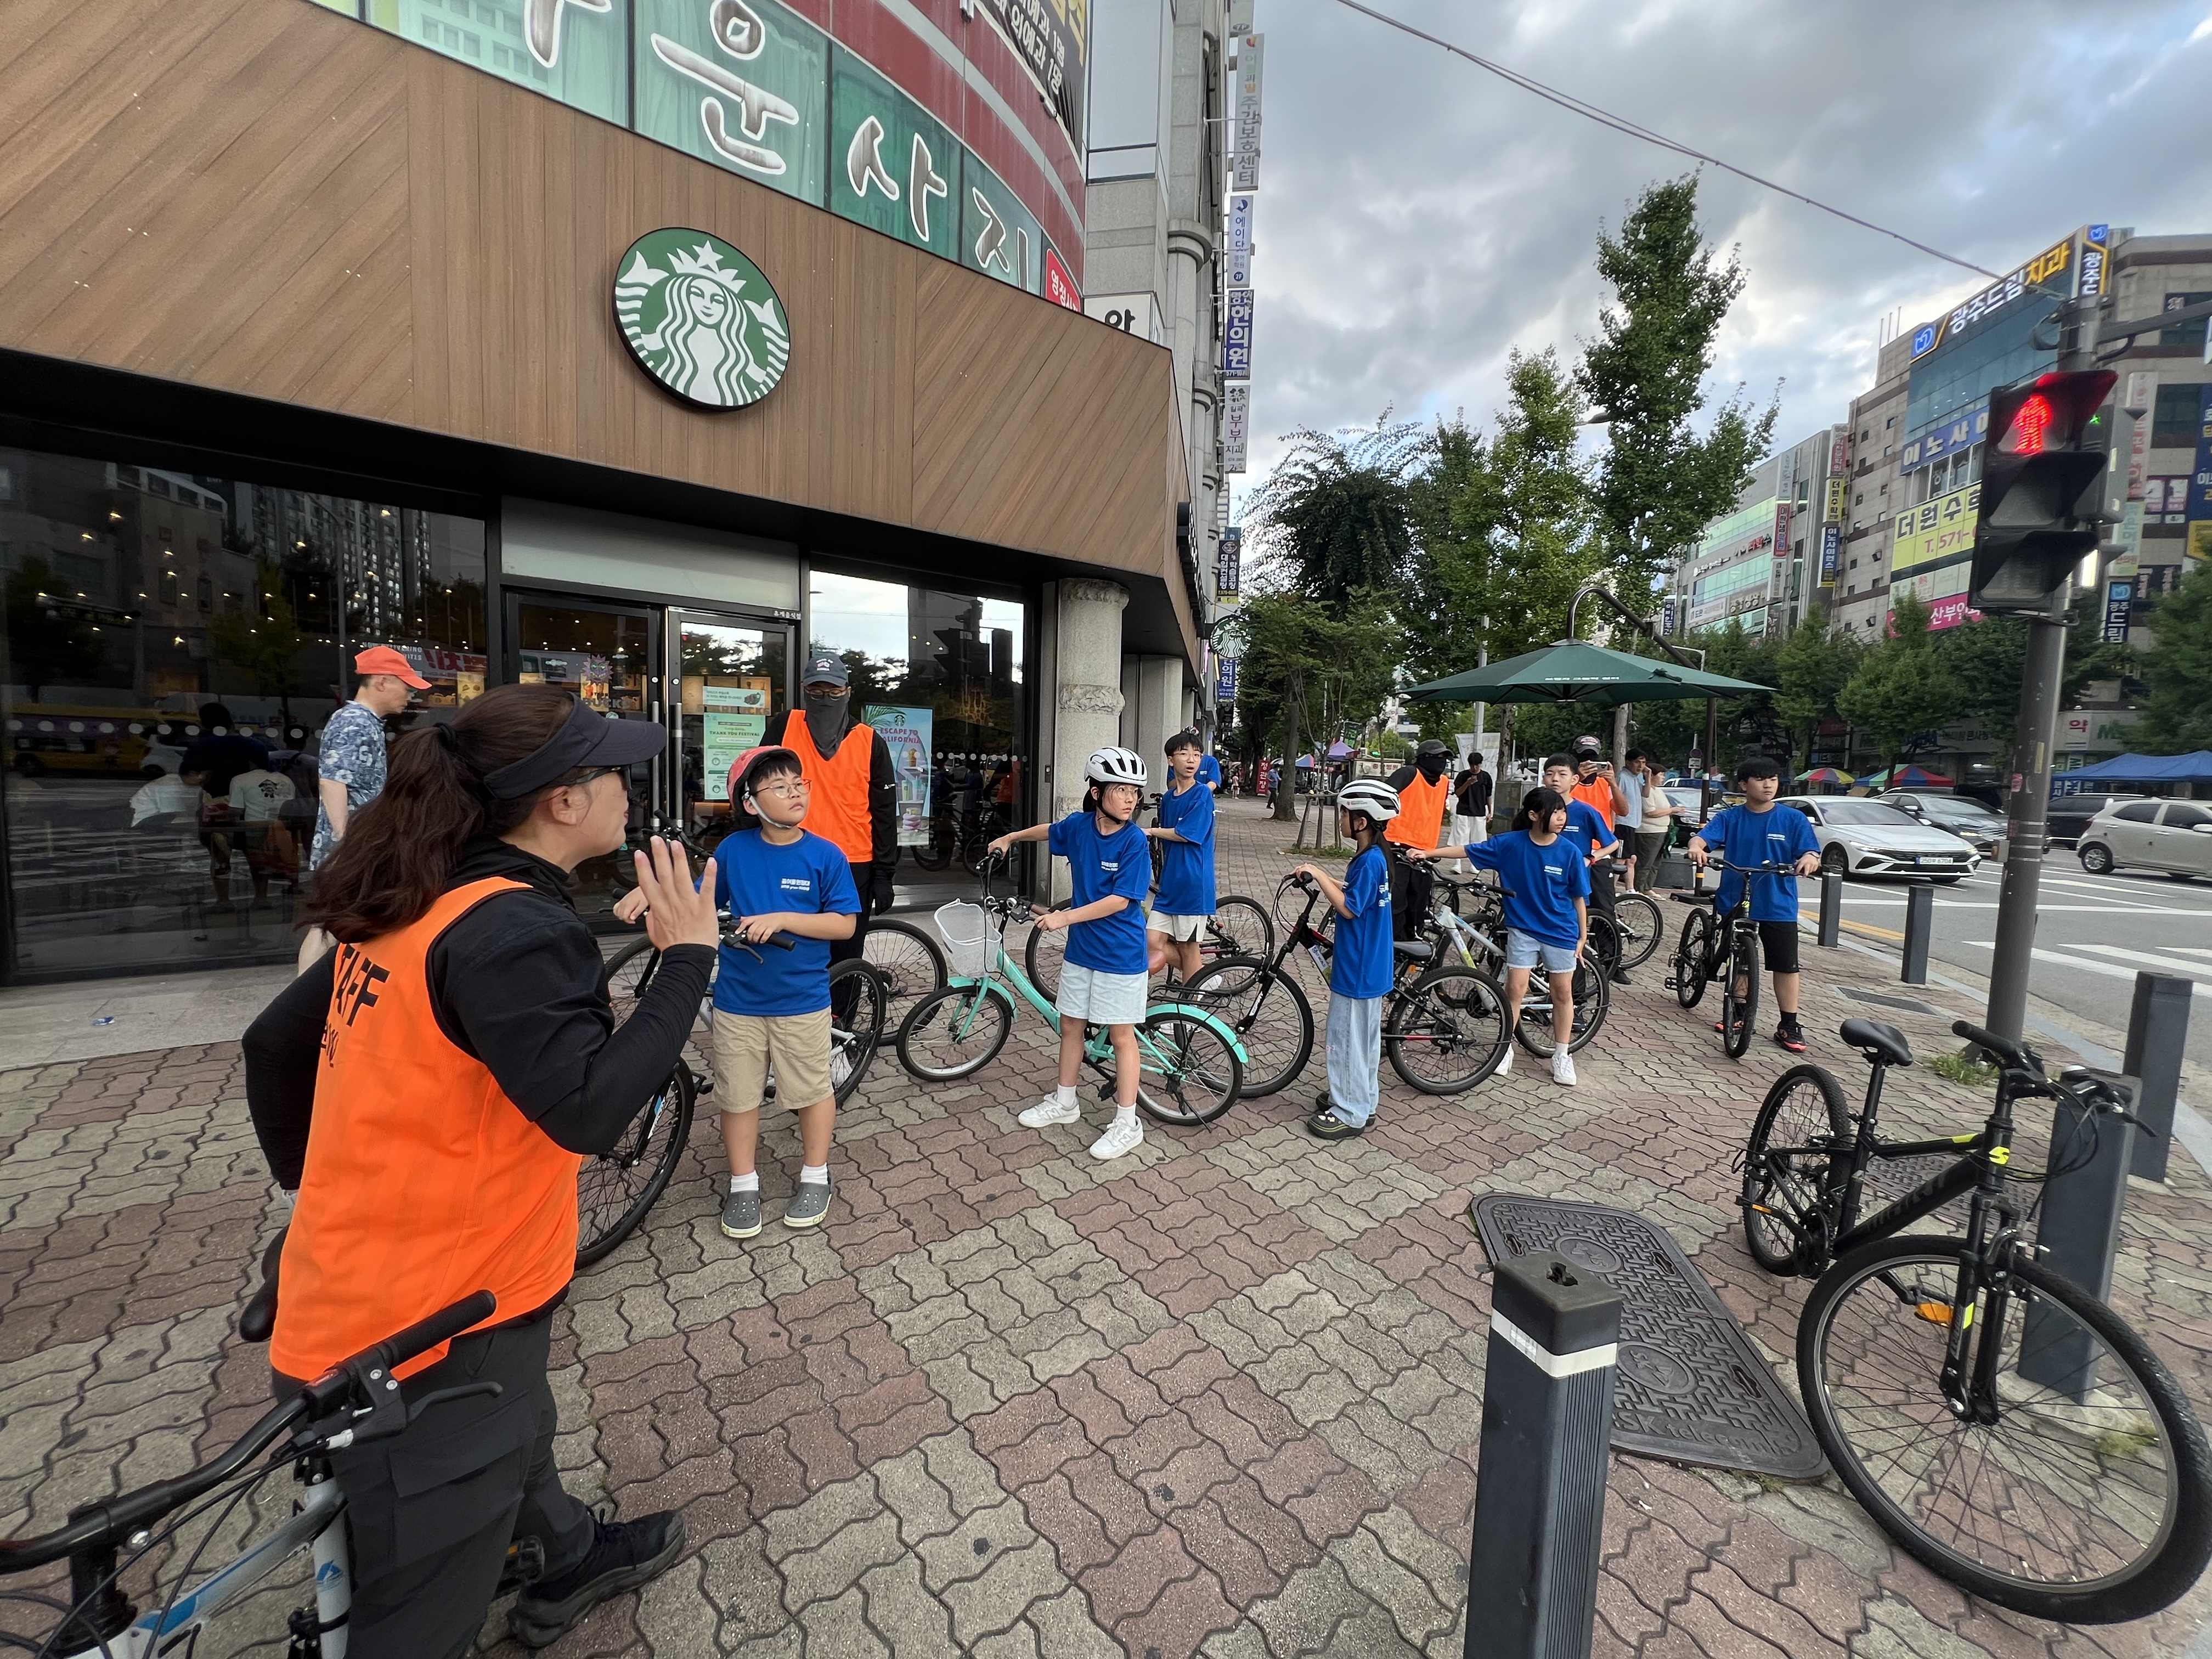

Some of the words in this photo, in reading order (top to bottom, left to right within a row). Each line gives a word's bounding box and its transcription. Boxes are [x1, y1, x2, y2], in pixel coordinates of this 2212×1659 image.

[1009, 4, 1046, 69] 의예과
[1048, 58, 1063, 94] 1명
[1949, 268, 2025, 335] 광주드림
[2025, 241, 2070, 286] 치과
[1229, 306, 1251, 368] 한의원
[1229, 414, 1243, 443] 부부
[1220, 554, 1228, 590] 대입컨설팅
[1229, 562, 1238, 590] 학습코칭
[774, 611, 801, 620] 휴게음식점
[2109, 602, 2129, 612] 광주
[2108, 612, 2126, 644] 드림
[883, 736, 922, 744] ALIFORNIA
[1259, 762, 1268, 789] 정관장
